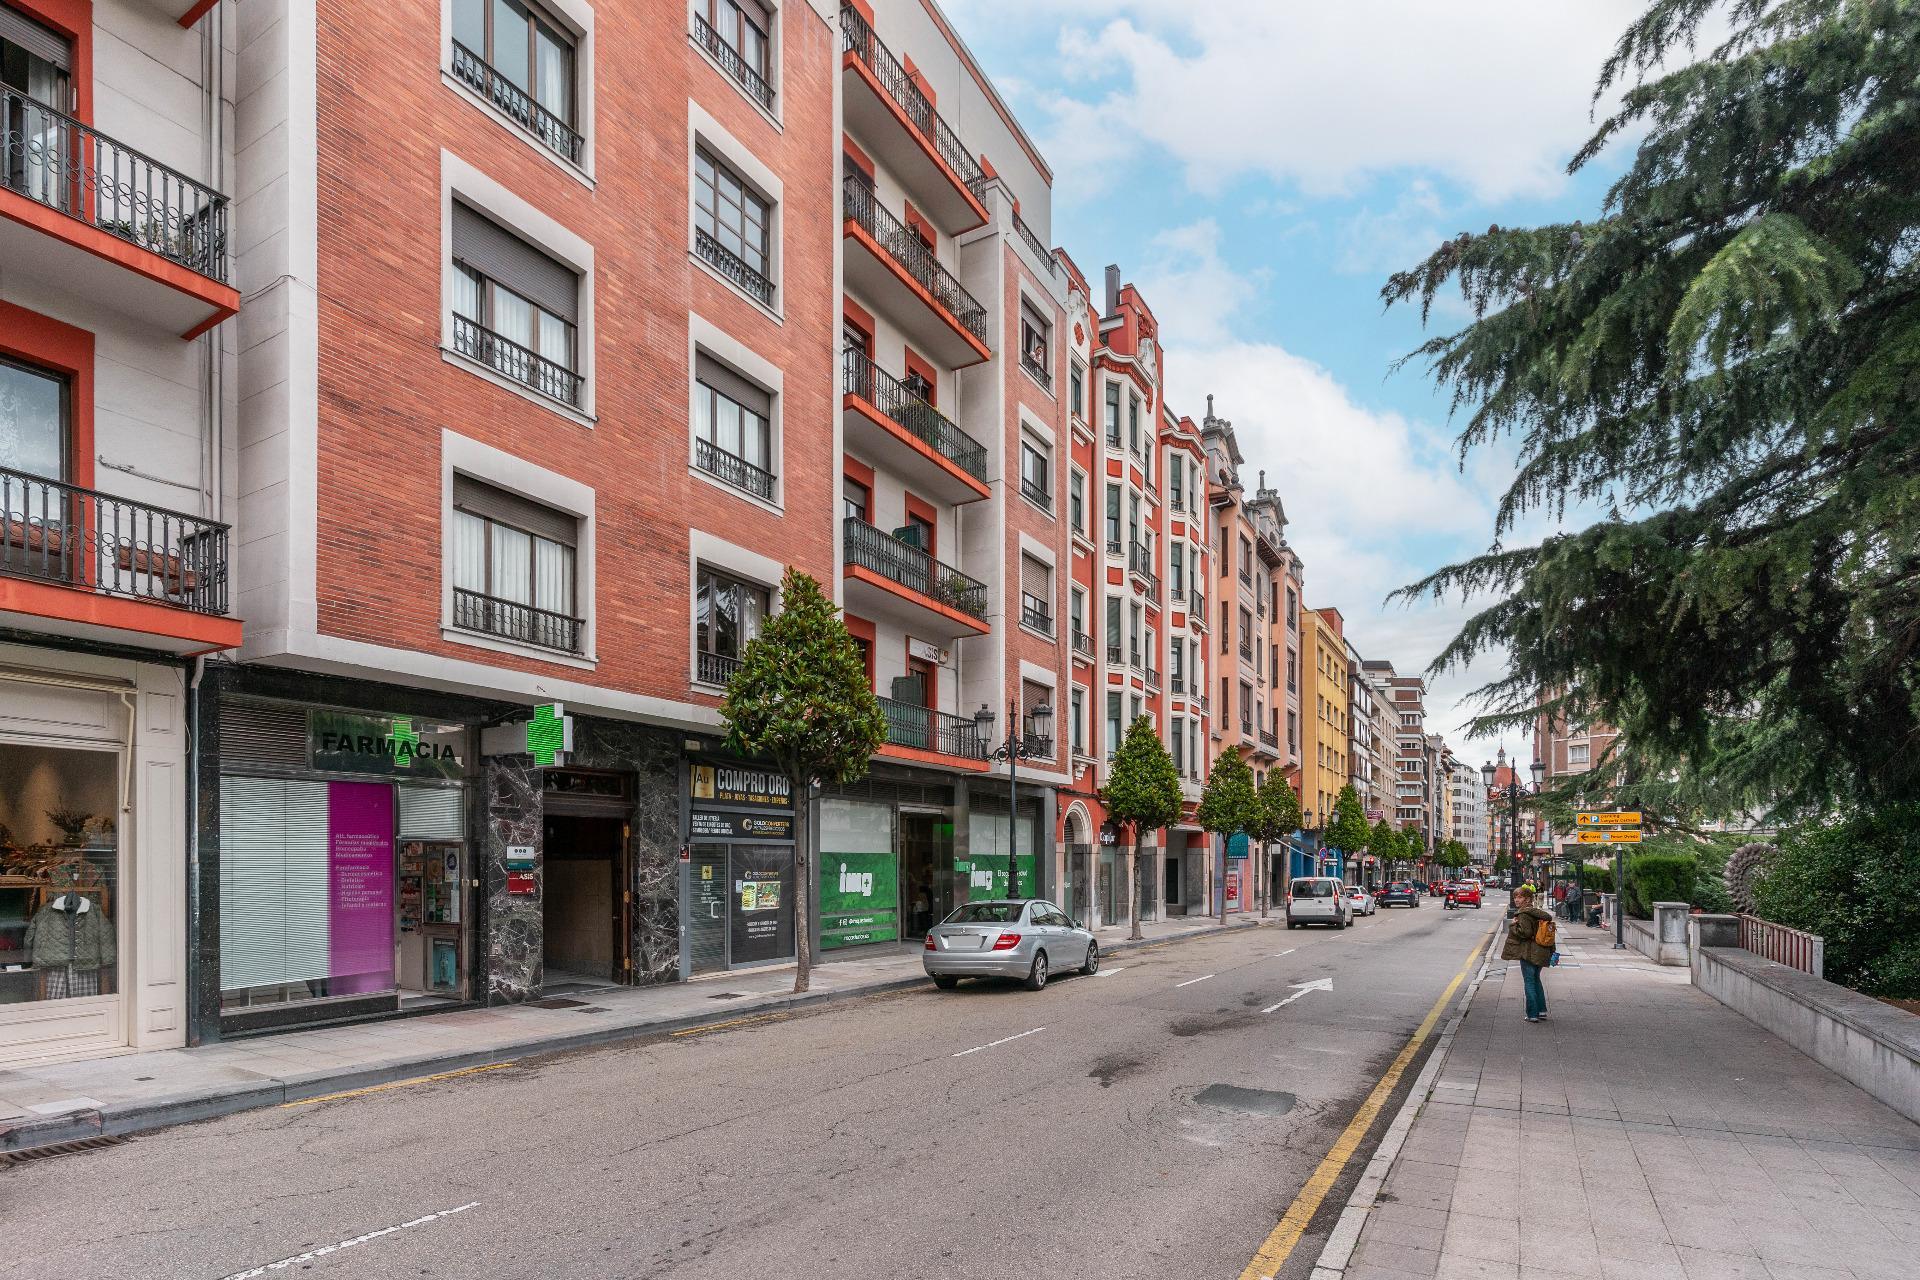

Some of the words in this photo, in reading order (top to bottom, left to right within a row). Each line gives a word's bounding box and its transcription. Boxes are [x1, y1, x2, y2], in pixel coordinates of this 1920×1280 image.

[323, 732, 456, 761] FARMACIA
[717, 769, 765, 794] COMPRO
[768, 775, 790, 796] ORO
